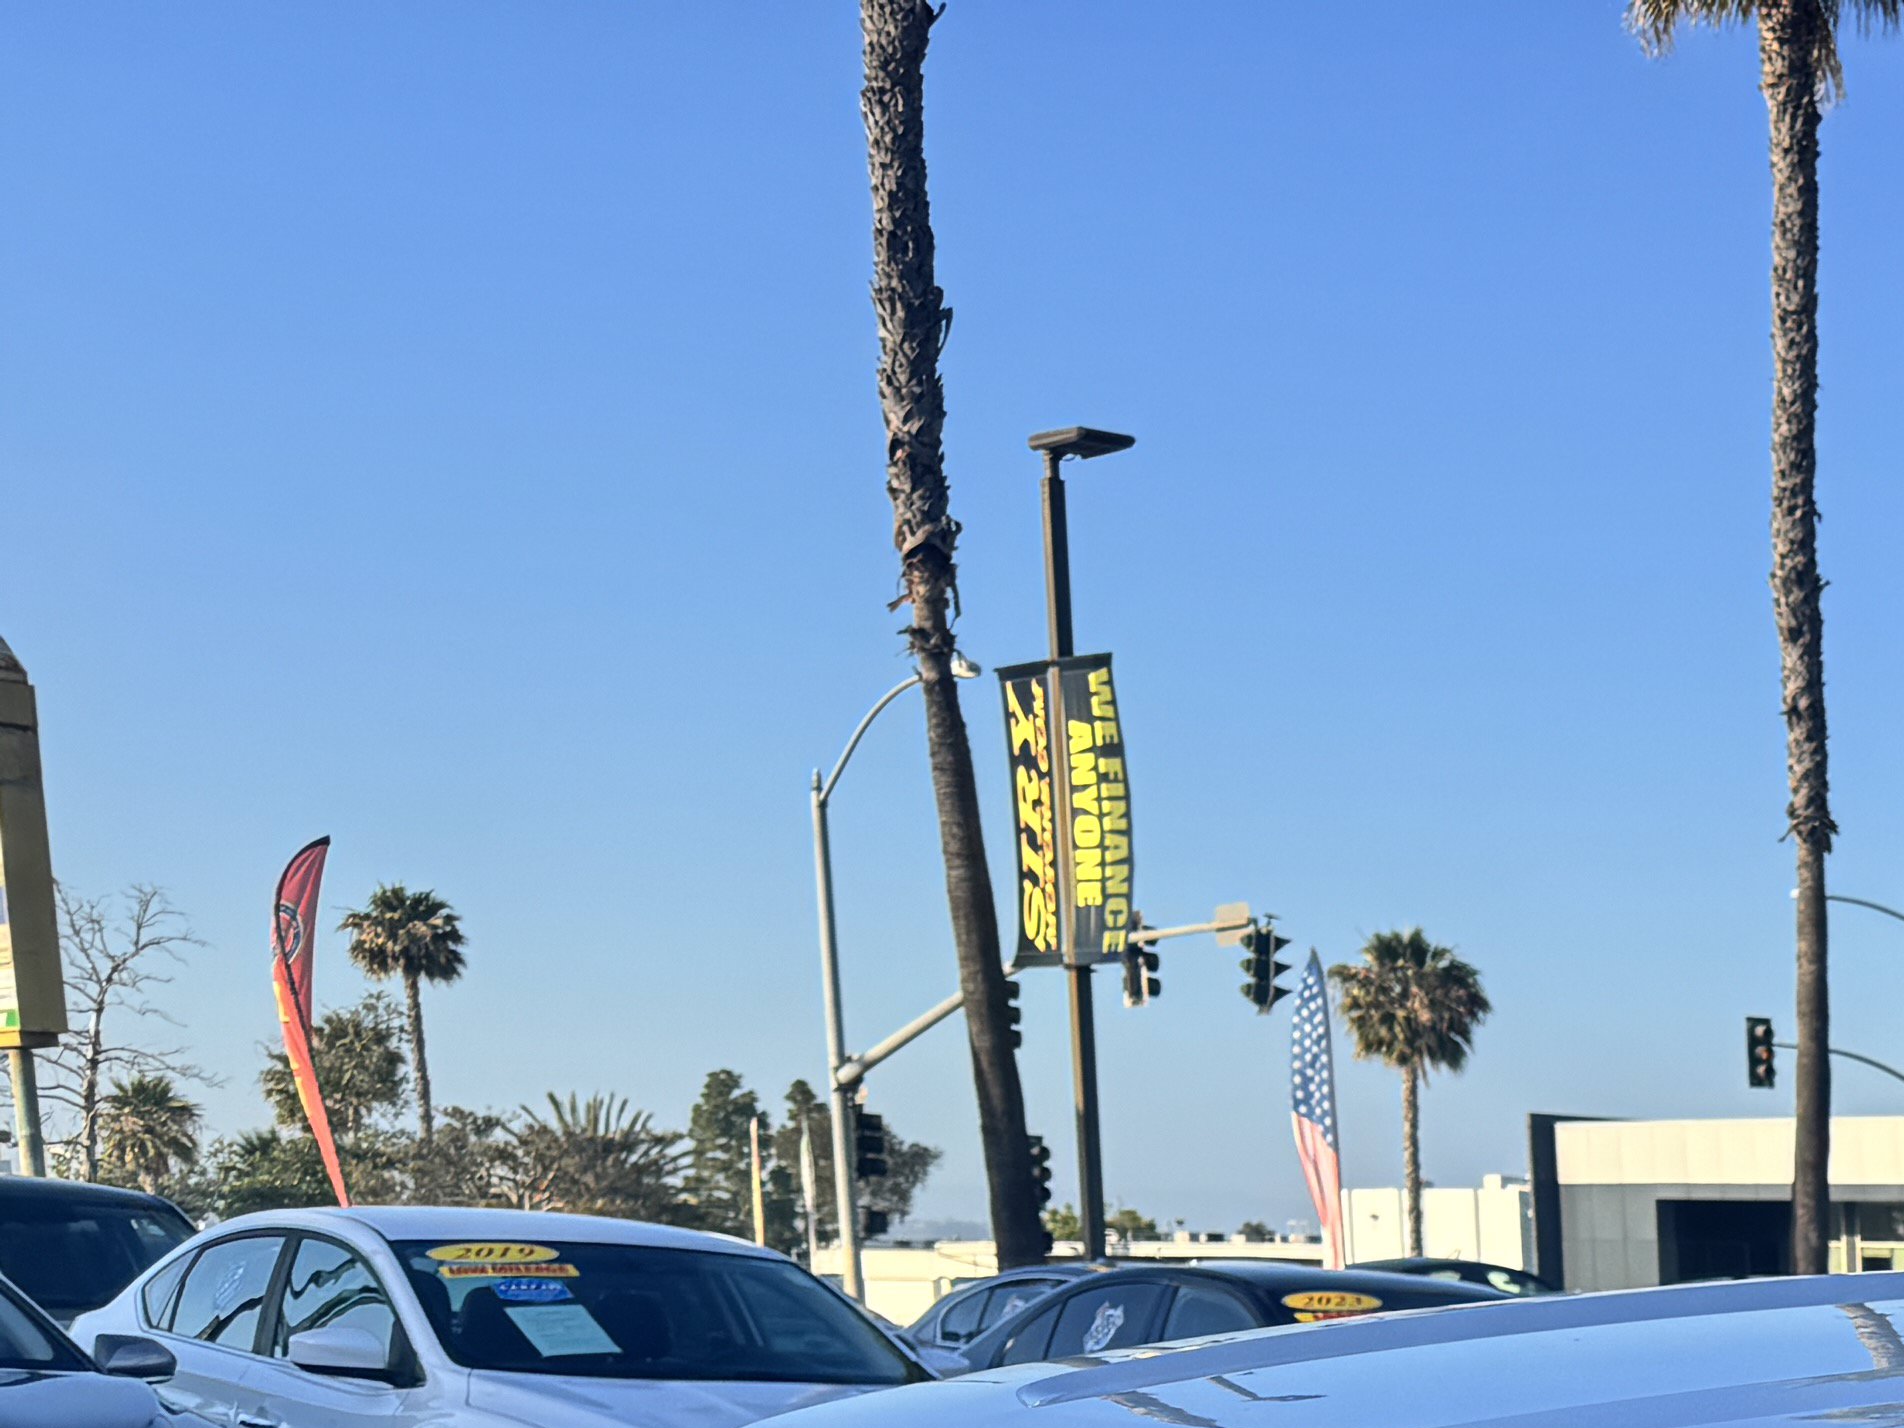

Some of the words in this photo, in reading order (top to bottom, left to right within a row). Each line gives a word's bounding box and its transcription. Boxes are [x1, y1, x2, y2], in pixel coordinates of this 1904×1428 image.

[1087, 667, 1119, 747] WE
[1067, 719, 1103, 908] ANYONE
[1098, 756, 1131, 954] FINANCE
[453, 1247, 536, 1260] 2019
